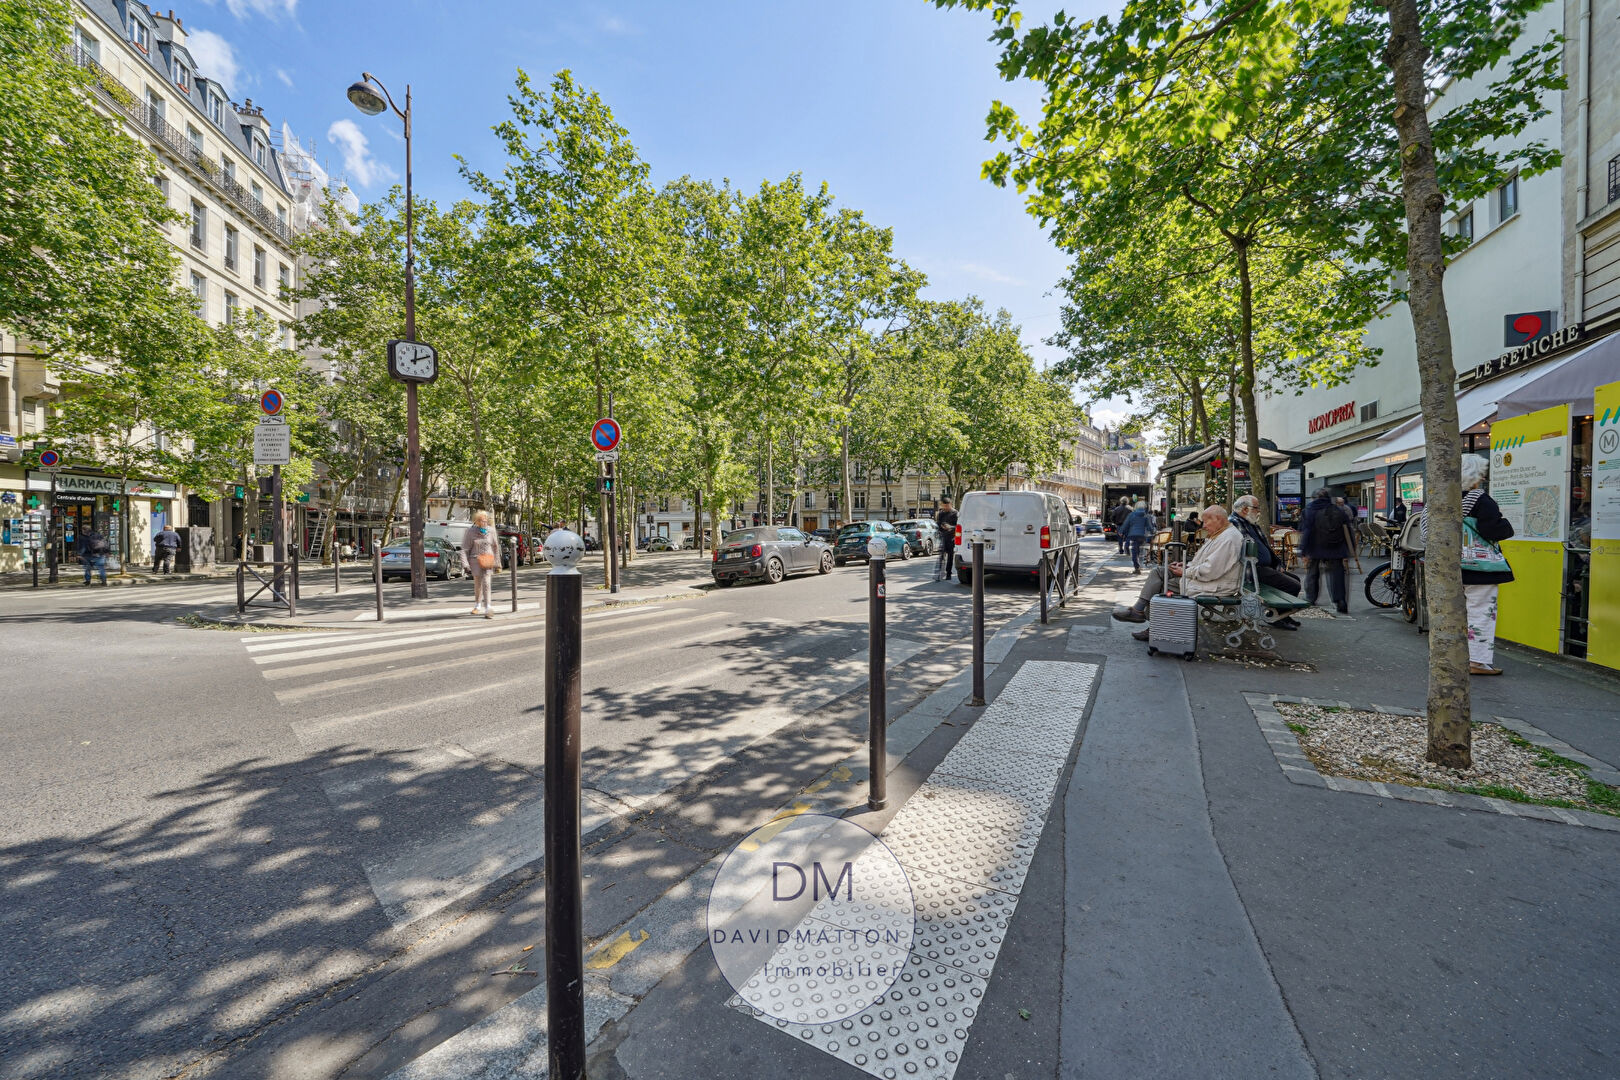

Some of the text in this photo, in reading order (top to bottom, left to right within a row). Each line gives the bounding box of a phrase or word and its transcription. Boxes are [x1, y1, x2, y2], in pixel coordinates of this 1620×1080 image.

[1475, 324, 1579, 379] LE FETICHE
[1308, 401, 1356, 434] MONOPRIX
